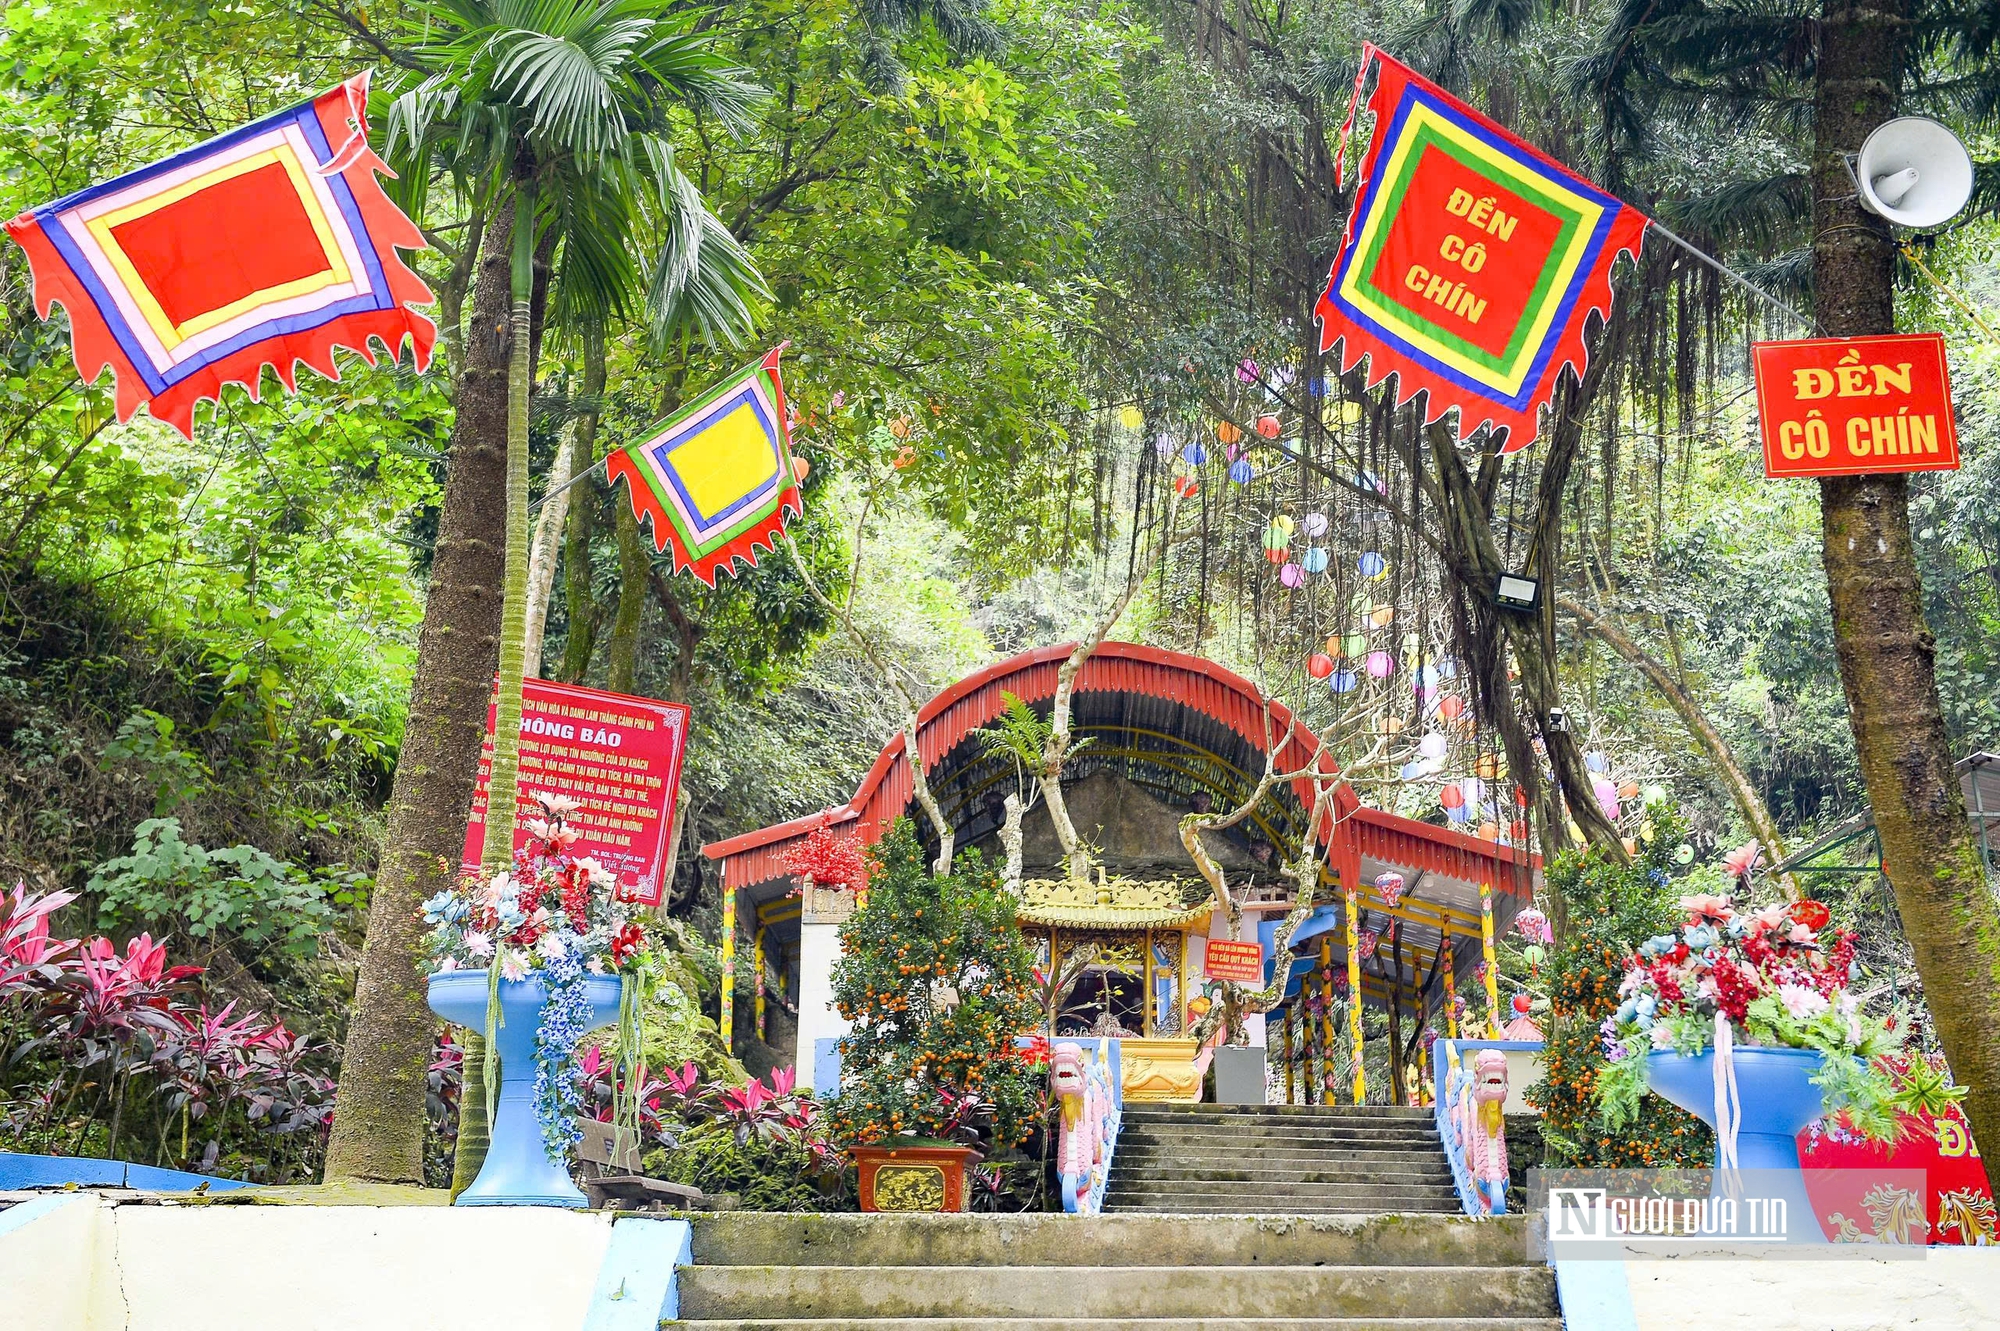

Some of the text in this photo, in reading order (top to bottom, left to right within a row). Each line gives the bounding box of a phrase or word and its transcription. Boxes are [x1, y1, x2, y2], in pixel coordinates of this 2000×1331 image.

[1445, 187, 1519, 242] ĐỀN
[1439, 234, 1487, 273] CÔ
[1404, 264, 1488, 325] CHÍN
[1792, 348, 1912, 400] ĐỀN
[1779, 406, 1939, 460] CÔ CHÍN
[569, 706, 585, 719] DANH
[585, 709, 598, 721] LAM
[645, 719, 655, 731] NA
[518, 716, 622, 748] HÔNG BÁO
[557, 759, 575, 773] CẢNH
[575, 764, 585, 776] TẠI
[585, 766, 599, 777] KHU
[599, 768, 607, 778] DI
[605, 751, 618, 765] CỦA
[618, 755, 627, 766] DU
[627, 757, 648, 770] KHÁCH
[557, 777, 573, 789] THAY
[588, 797, 602, 810] TÍCH
[611, 802, 627, 815] NGHỊ
[627, 804, 636, 815] DU
[636, 806, 657, 819] KHÁCH
[584, 829, 602, 842] XUÂN
[633, 855, 645, 863] BAN
[1208, 952, 1258, 965] YÊU CẦU QUÝ KHÁCH
